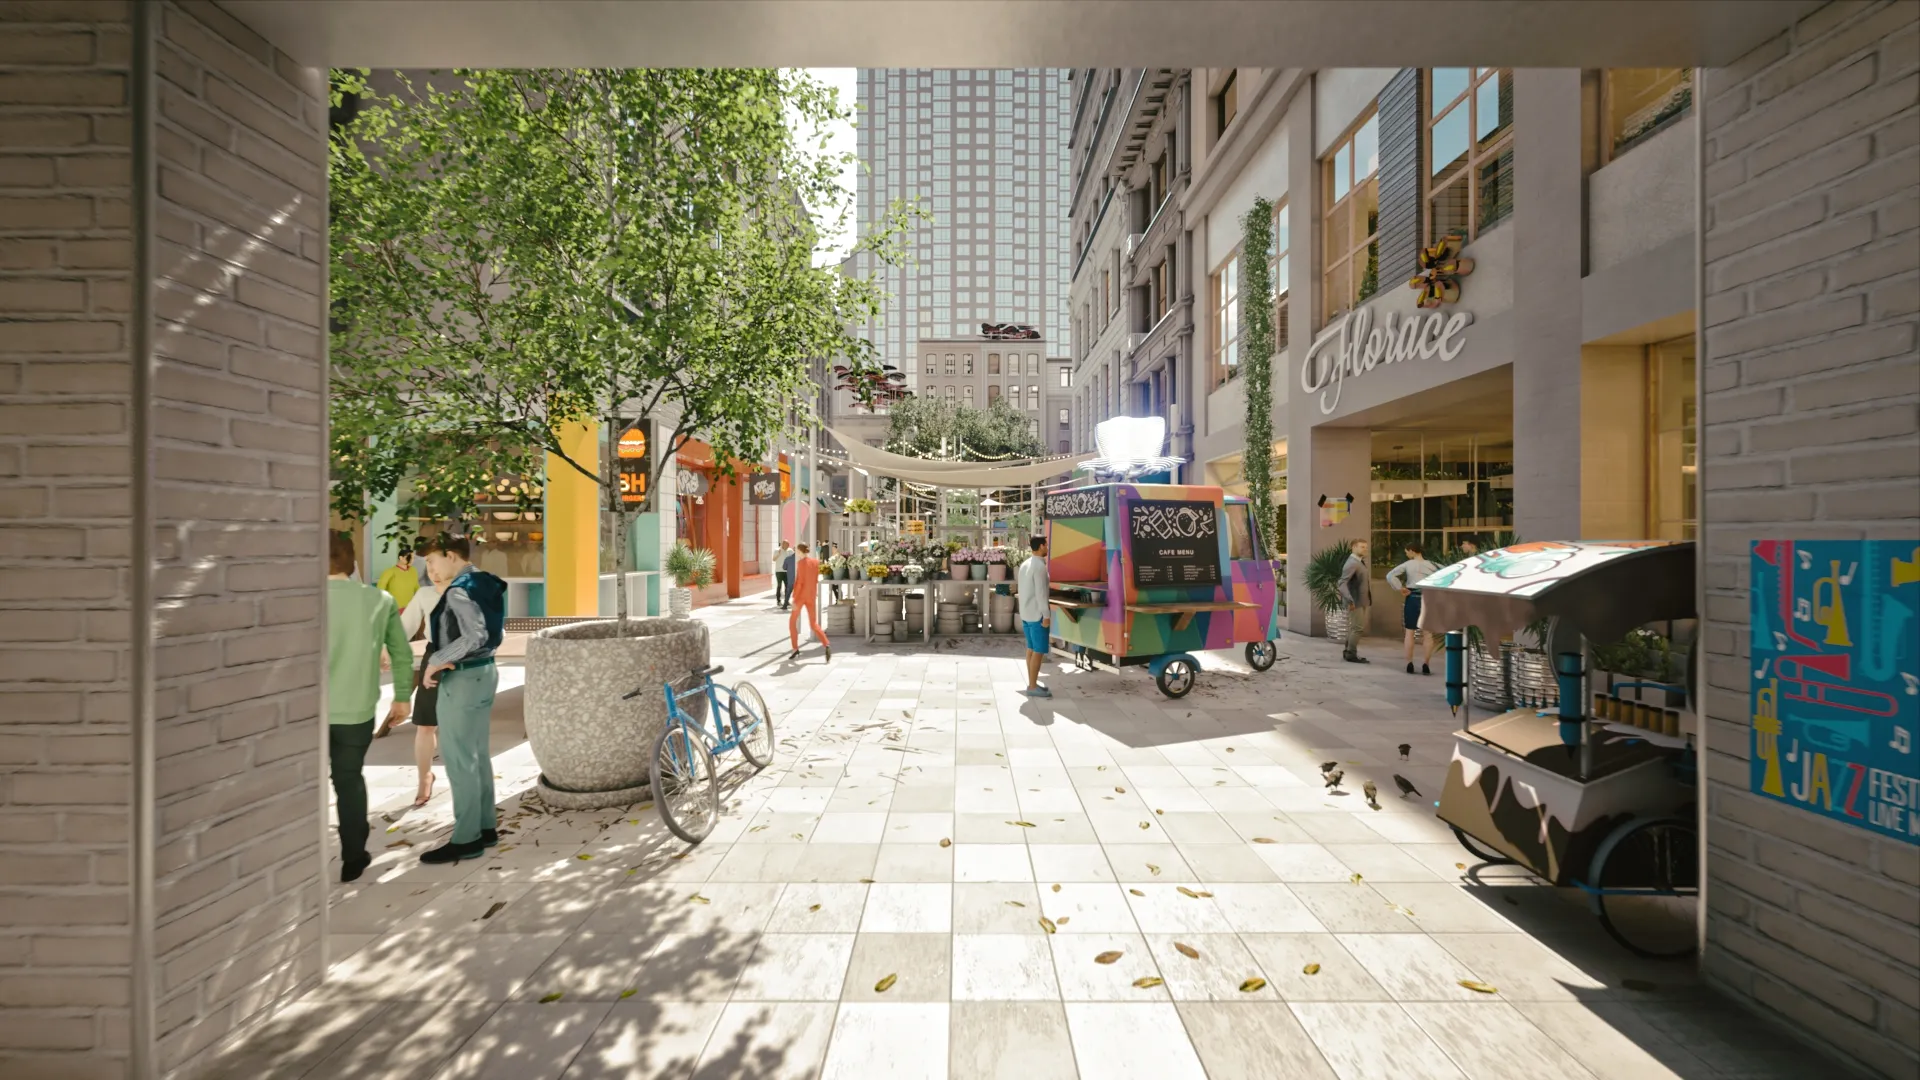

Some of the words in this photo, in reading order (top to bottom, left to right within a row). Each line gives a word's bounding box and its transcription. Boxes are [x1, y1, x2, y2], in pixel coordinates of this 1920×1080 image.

[1301, 305, 1472, 415] Florace
[1790, 750, 1867, 819] JAZZ
[1869, 767, 1920, 810] FEST
[1869, 800, 1906, 833] LIVE
